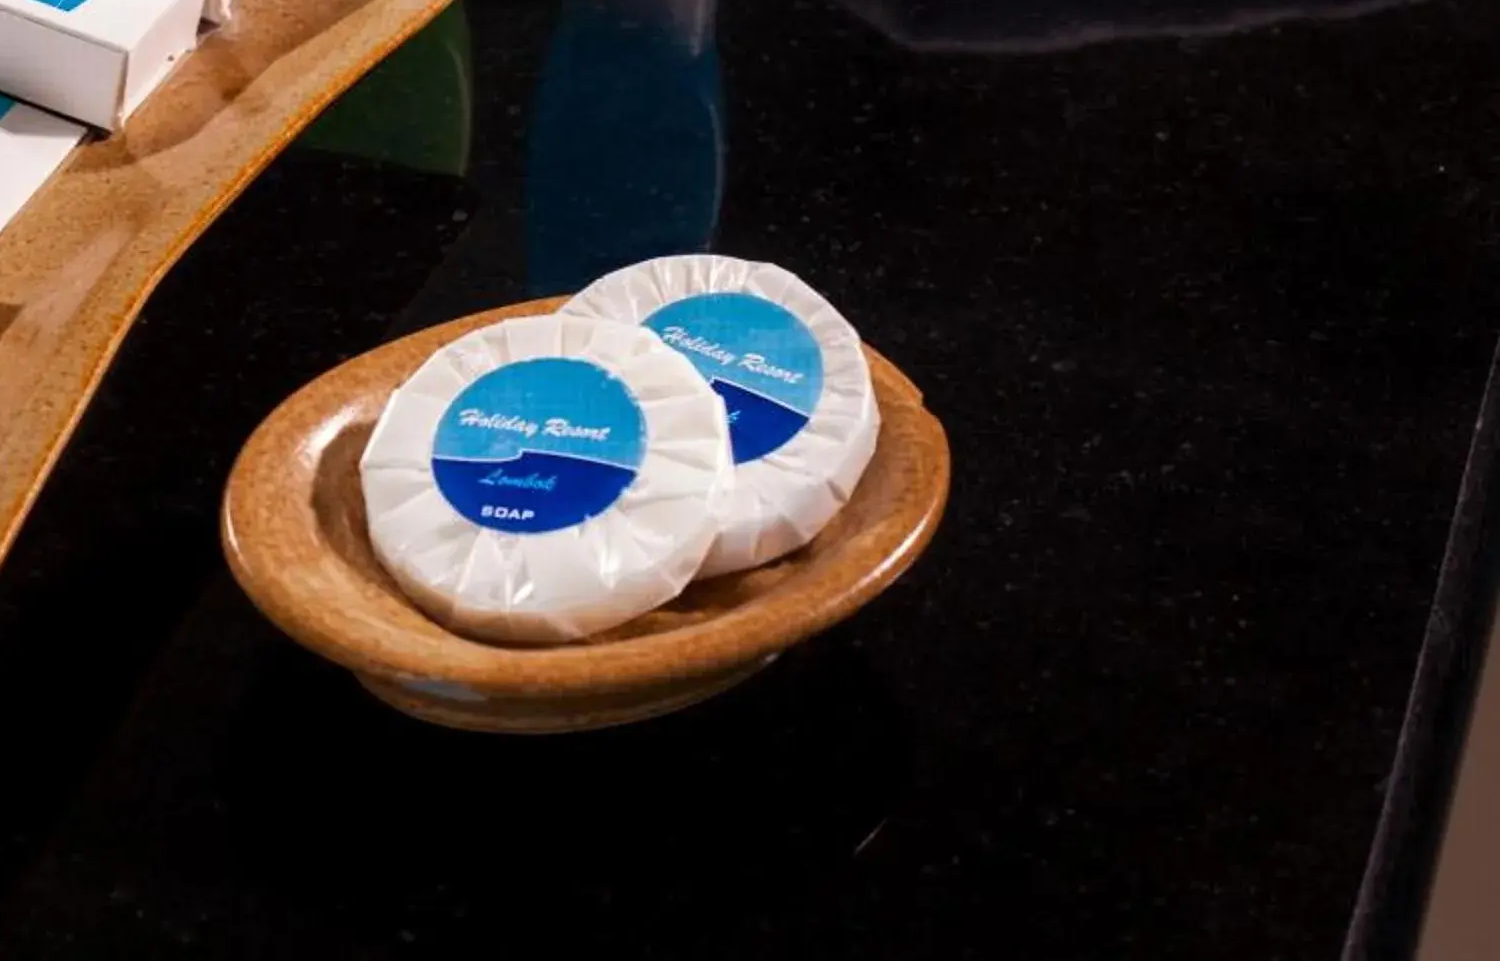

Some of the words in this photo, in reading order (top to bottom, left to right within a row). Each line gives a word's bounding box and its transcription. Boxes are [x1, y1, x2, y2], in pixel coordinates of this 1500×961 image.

[662, 326, 736, 366] Holiday
[737, 351, 804, 385] Resort
[458, 407, 539, 438] Holiday
[542, 416, 611, 441] Resort
[477, 468, 556, 491] Lombok
[480, 503, 535, 521] SOAP
